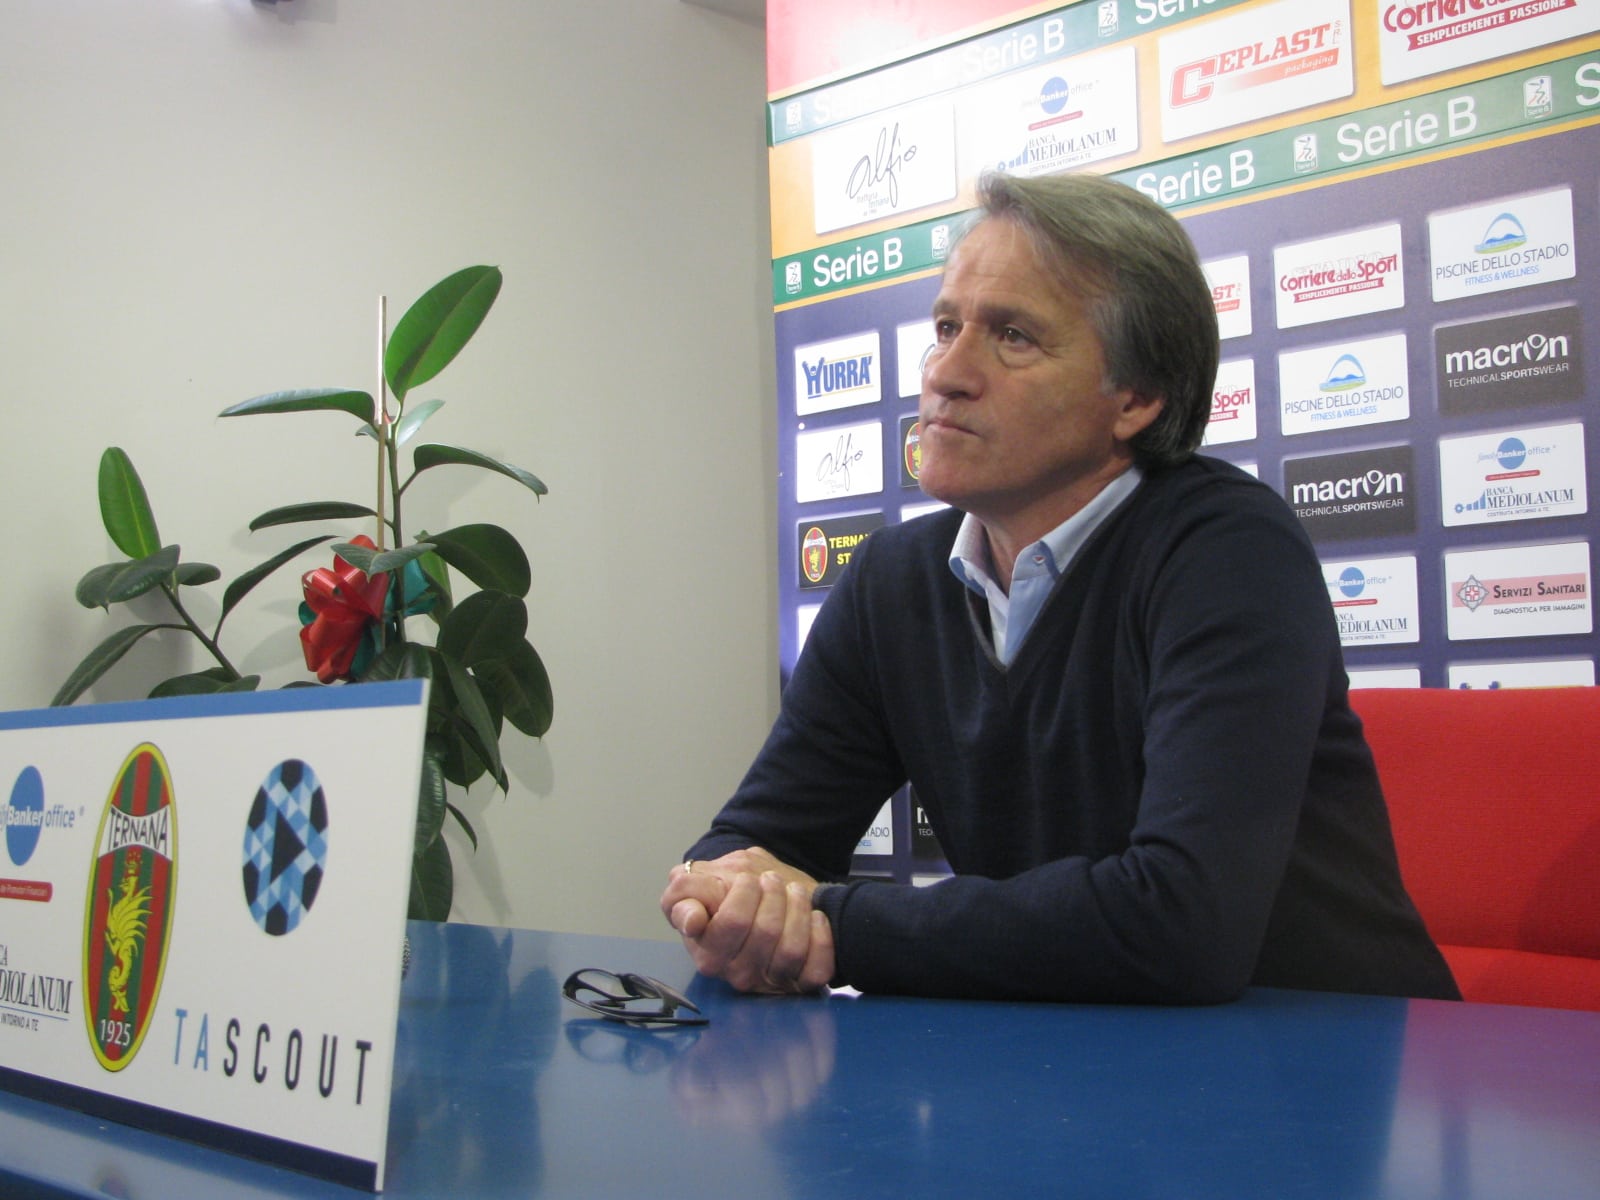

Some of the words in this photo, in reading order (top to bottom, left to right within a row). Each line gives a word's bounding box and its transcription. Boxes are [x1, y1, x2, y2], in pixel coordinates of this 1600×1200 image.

[1043, 18, 1066, 54] B
[1416, 14, 1505, 46] SEMPLICEMENTE
[1169, 22, 1331, 110] CEPLAST
[1285, 54, 1335, 75] packaging
[1028, 132, 1055, 148] BANCA
[1337, 110, 1439, 163] Serie
[1448, 95, 1478, 138] B
[1029, 127, 1117, 162] MEDIOLANUM
[1136, 161, 1223, 205] Serie
[1229, 150, 1255, 188] B
[813, 246, 879, 287] Serie
[883, 237, 903, 272] B
[1280, 270, 1336, 292] Corriere
[1357, 254, 1397, 281] Sport
[1436, 260, 1479, 280] PISCINE
[1482, 252, 1521, 272] DELLO
[1523, 243, 1569, 264] STADIO
[1465, 273, 1493, 286] FITNESS
[1501, 265, 1540, 278] WELLNESS
[1214, 387, 1250, 412] Sport
[1284, 398, 1323, 414] PISCINE
[1326, 392, 1361, 409] DELLO
[1362, 386, 1404, 404] STADIO
[1310, 411, 1336, 422] FITNESS
[1343, 405, 1377, 417] WELLNESS
[1527, 445, 1551, 456] office
[1486, 486, 1514, 497] BANCA
[1487, 488, 1574, 510] MEDIOLANUM
[829, 533, 868, 549] TERNA
[1366, 575, 1387, 585] office
[1493, 606, 1538, 615] DIAGNOSTICA
[1553, 603, 1585, 611] IMMAGINI
[45, 804, 75, 828] office
[107, 806, 168, 856] TERNANA
[0, 968, 73, 1014] DIOLANUM
[32, 1018, 39, 1032] TE
[100, 1018, 132, 1046] 1925
